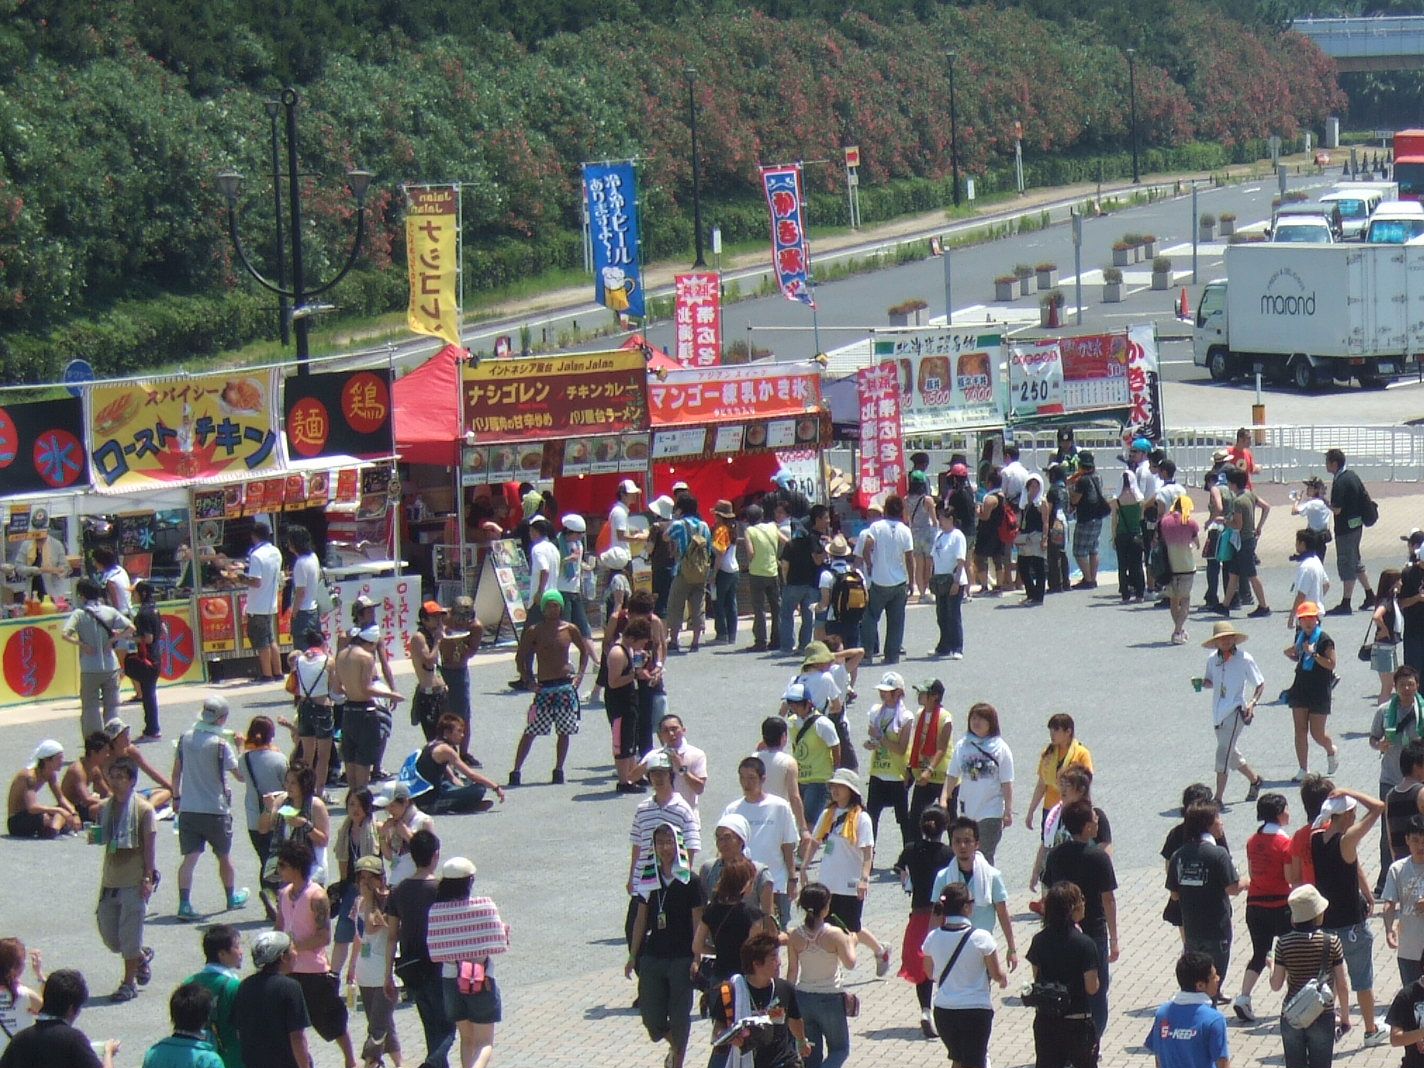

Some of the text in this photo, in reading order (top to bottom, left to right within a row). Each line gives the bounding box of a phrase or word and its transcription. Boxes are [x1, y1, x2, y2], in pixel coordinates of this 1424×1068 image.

[145, 385, 219, 407] スパイシー
[468, 381, 550, 407] ナシゴレン
[1020, 379, 1049, 402] 250
[37, 434, 81, 482] 氷
